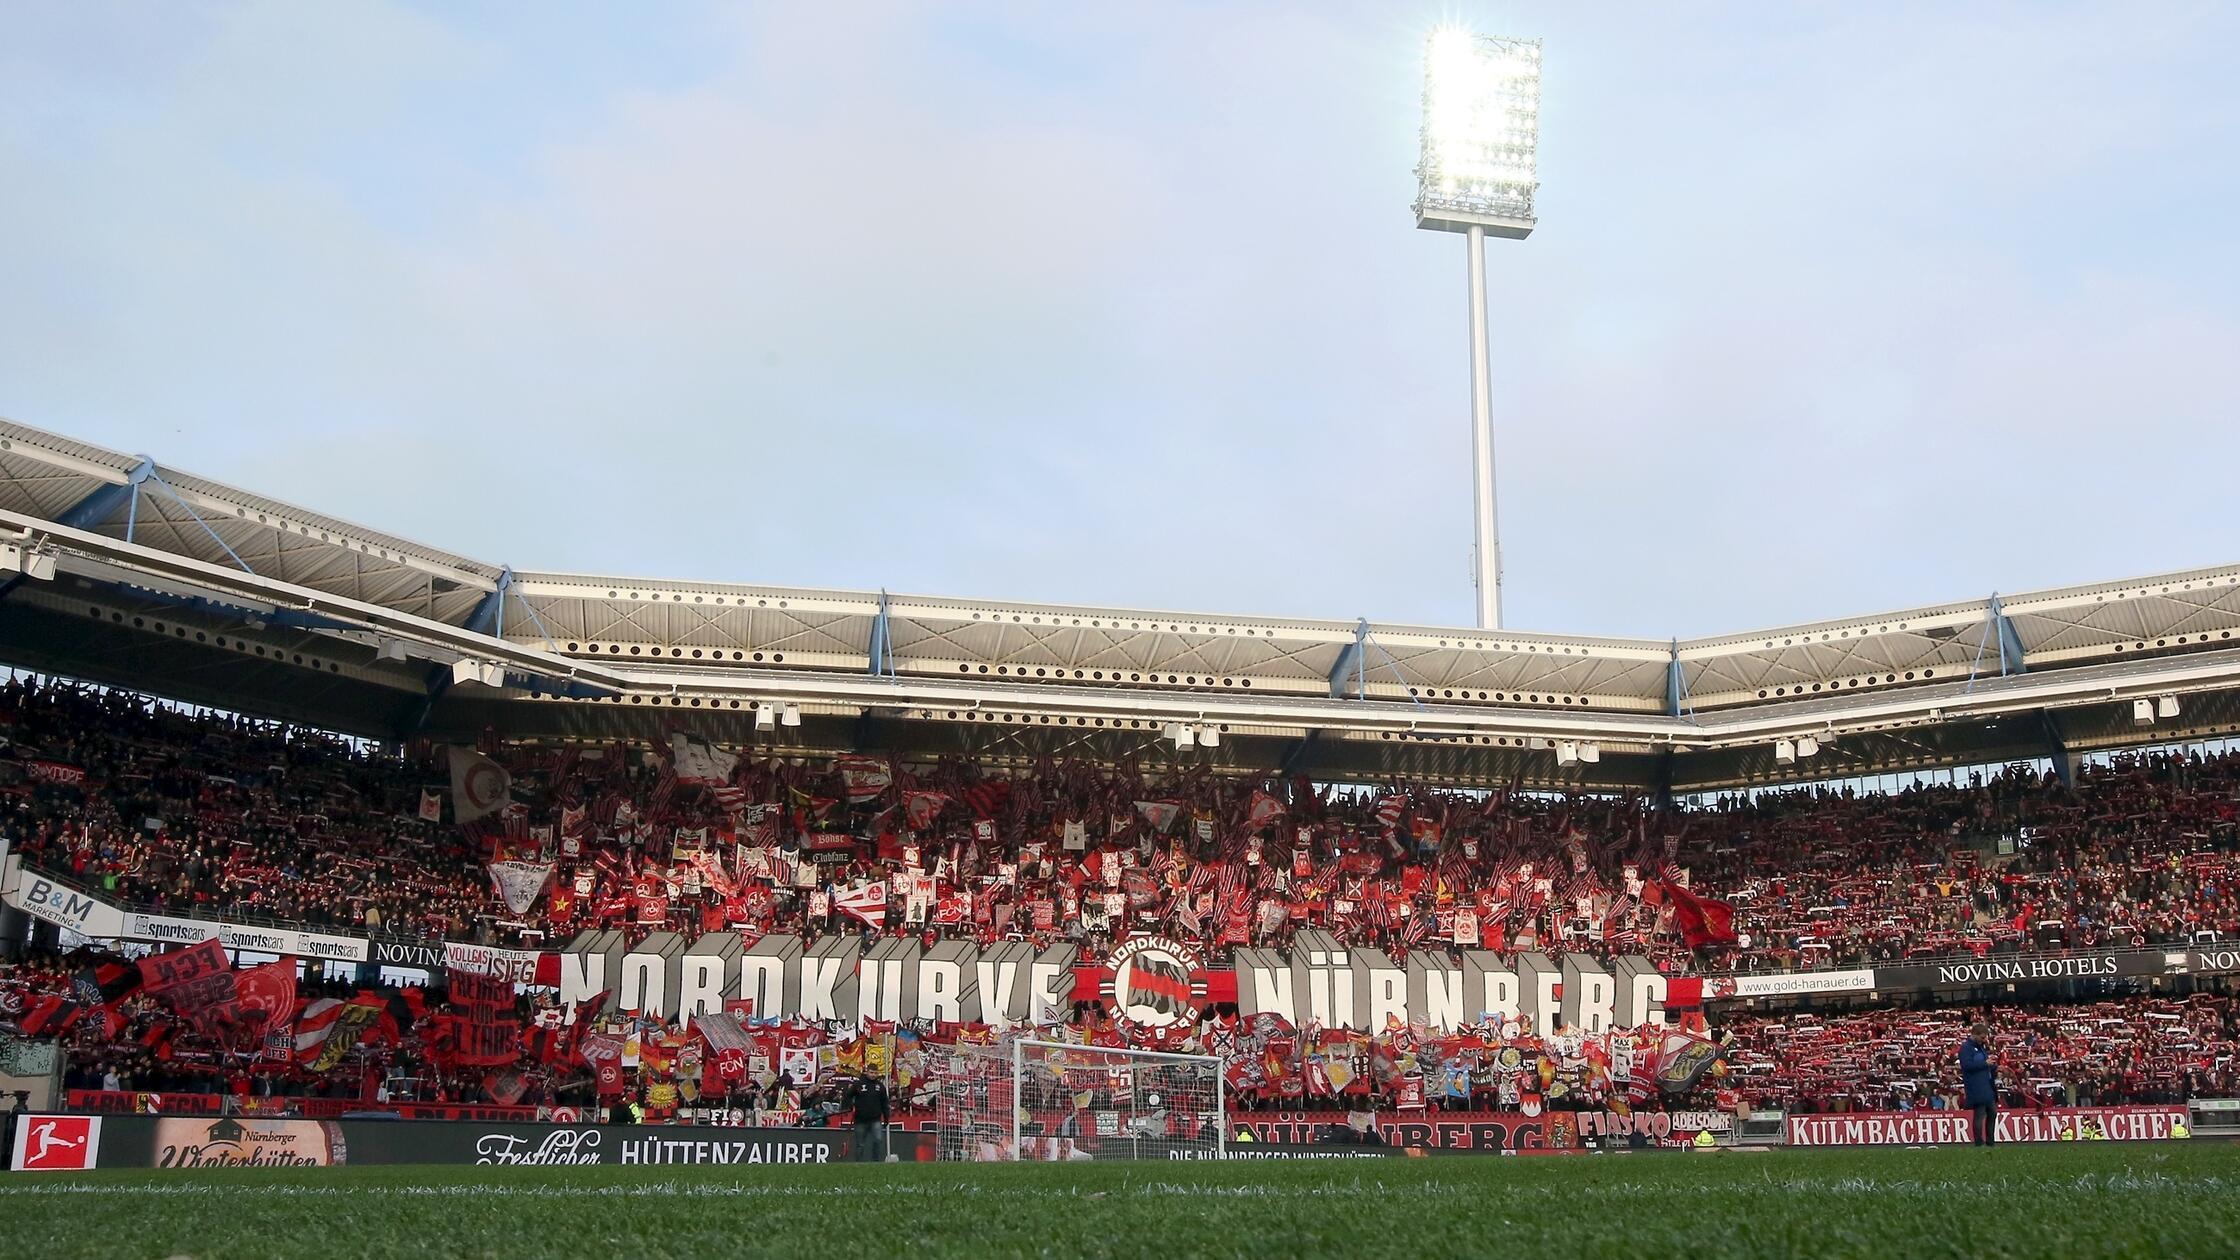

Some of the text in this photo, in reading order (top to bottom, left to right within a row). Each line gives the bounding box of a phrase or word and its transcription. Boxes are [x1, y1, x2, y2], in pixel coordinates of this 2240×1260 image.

[22, 901, 74, 928] MARKETING
[27, 879, 95, 922] B&M
[376, 942, 449, 967] NOVINA
[450, 947, 489, 965] VOLLGAS
[1106, 936, 1200, 972] NORDKURVE
[492, 958, 535, 984] SIEG
[1939, 955, 2119, 984] NOVINA HOTELS
[560, 950, 1066, 1031] NORDKURVE
[1254, 949, 1667, 1036] NÜRNBERG
[1743, 974, 1868, 994] www.gold-hanauer.de
[719, 1057, 745, 1075] FCN
[245, 1130, 297, 1143] Nürnberger
[1577, 1111, 1671, 1138] FIASKO
[1790, 1116, 1972, 1145] KULMBACHER
[476, 1129, 601, 1165] Festlicher
[621, 1136, 830, 1165] HÜTTENZAUBER
